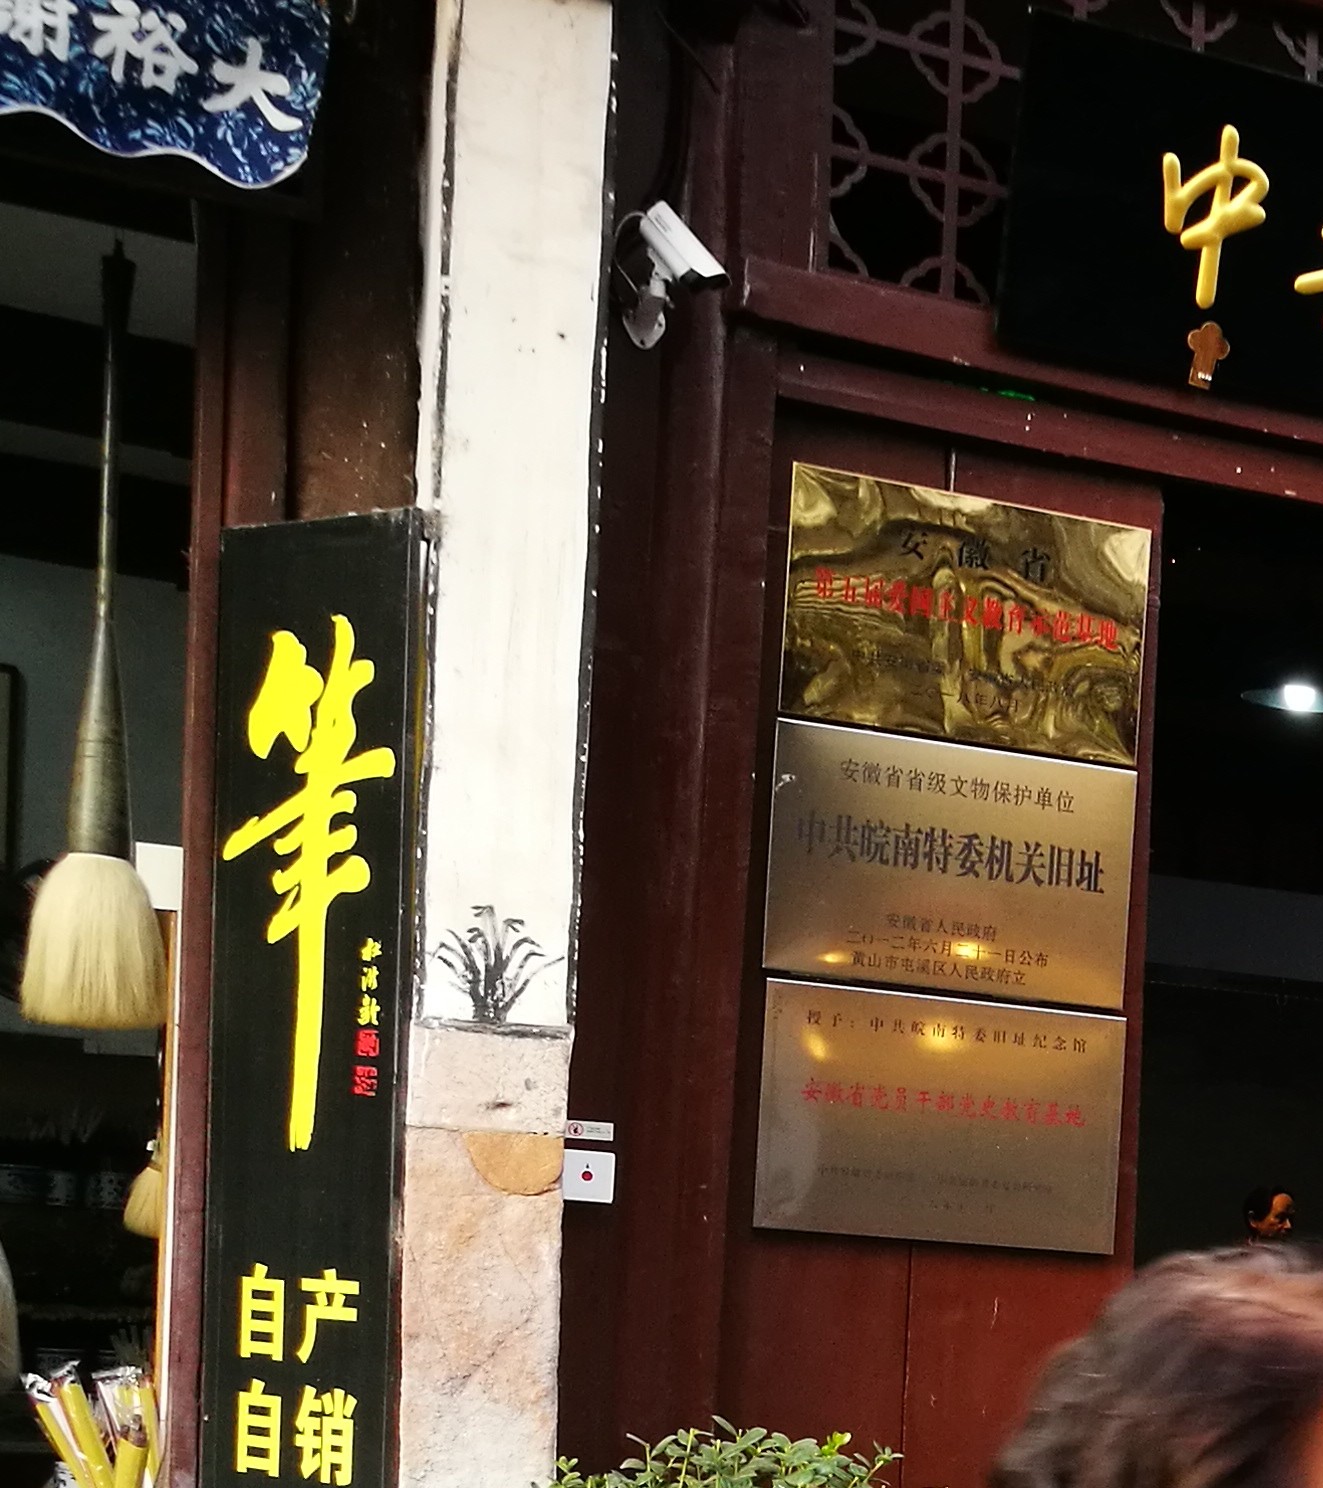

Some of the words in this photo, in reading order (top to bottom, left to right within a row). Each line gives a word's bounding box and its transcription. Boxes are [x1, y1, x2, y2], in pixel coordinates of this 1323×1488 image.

[898, 527, 1051, 583] 安徽省
[840, 757, 1076, 814] 安徽省省级文物保护单位
[795, 810, 1106, 894] 中共皖南特委机关旧址
[885, 912, 998, 943] 安徽省人民政府
[851, 950, 1027, 986] 黄山市屯溪区人民政府立
[800, 1077, 1087, 1128] 安徽省党员干部党史教育基地
[238, 1262, 360, 1365] 自产
[234, 1378, 358, 1486] 自销
